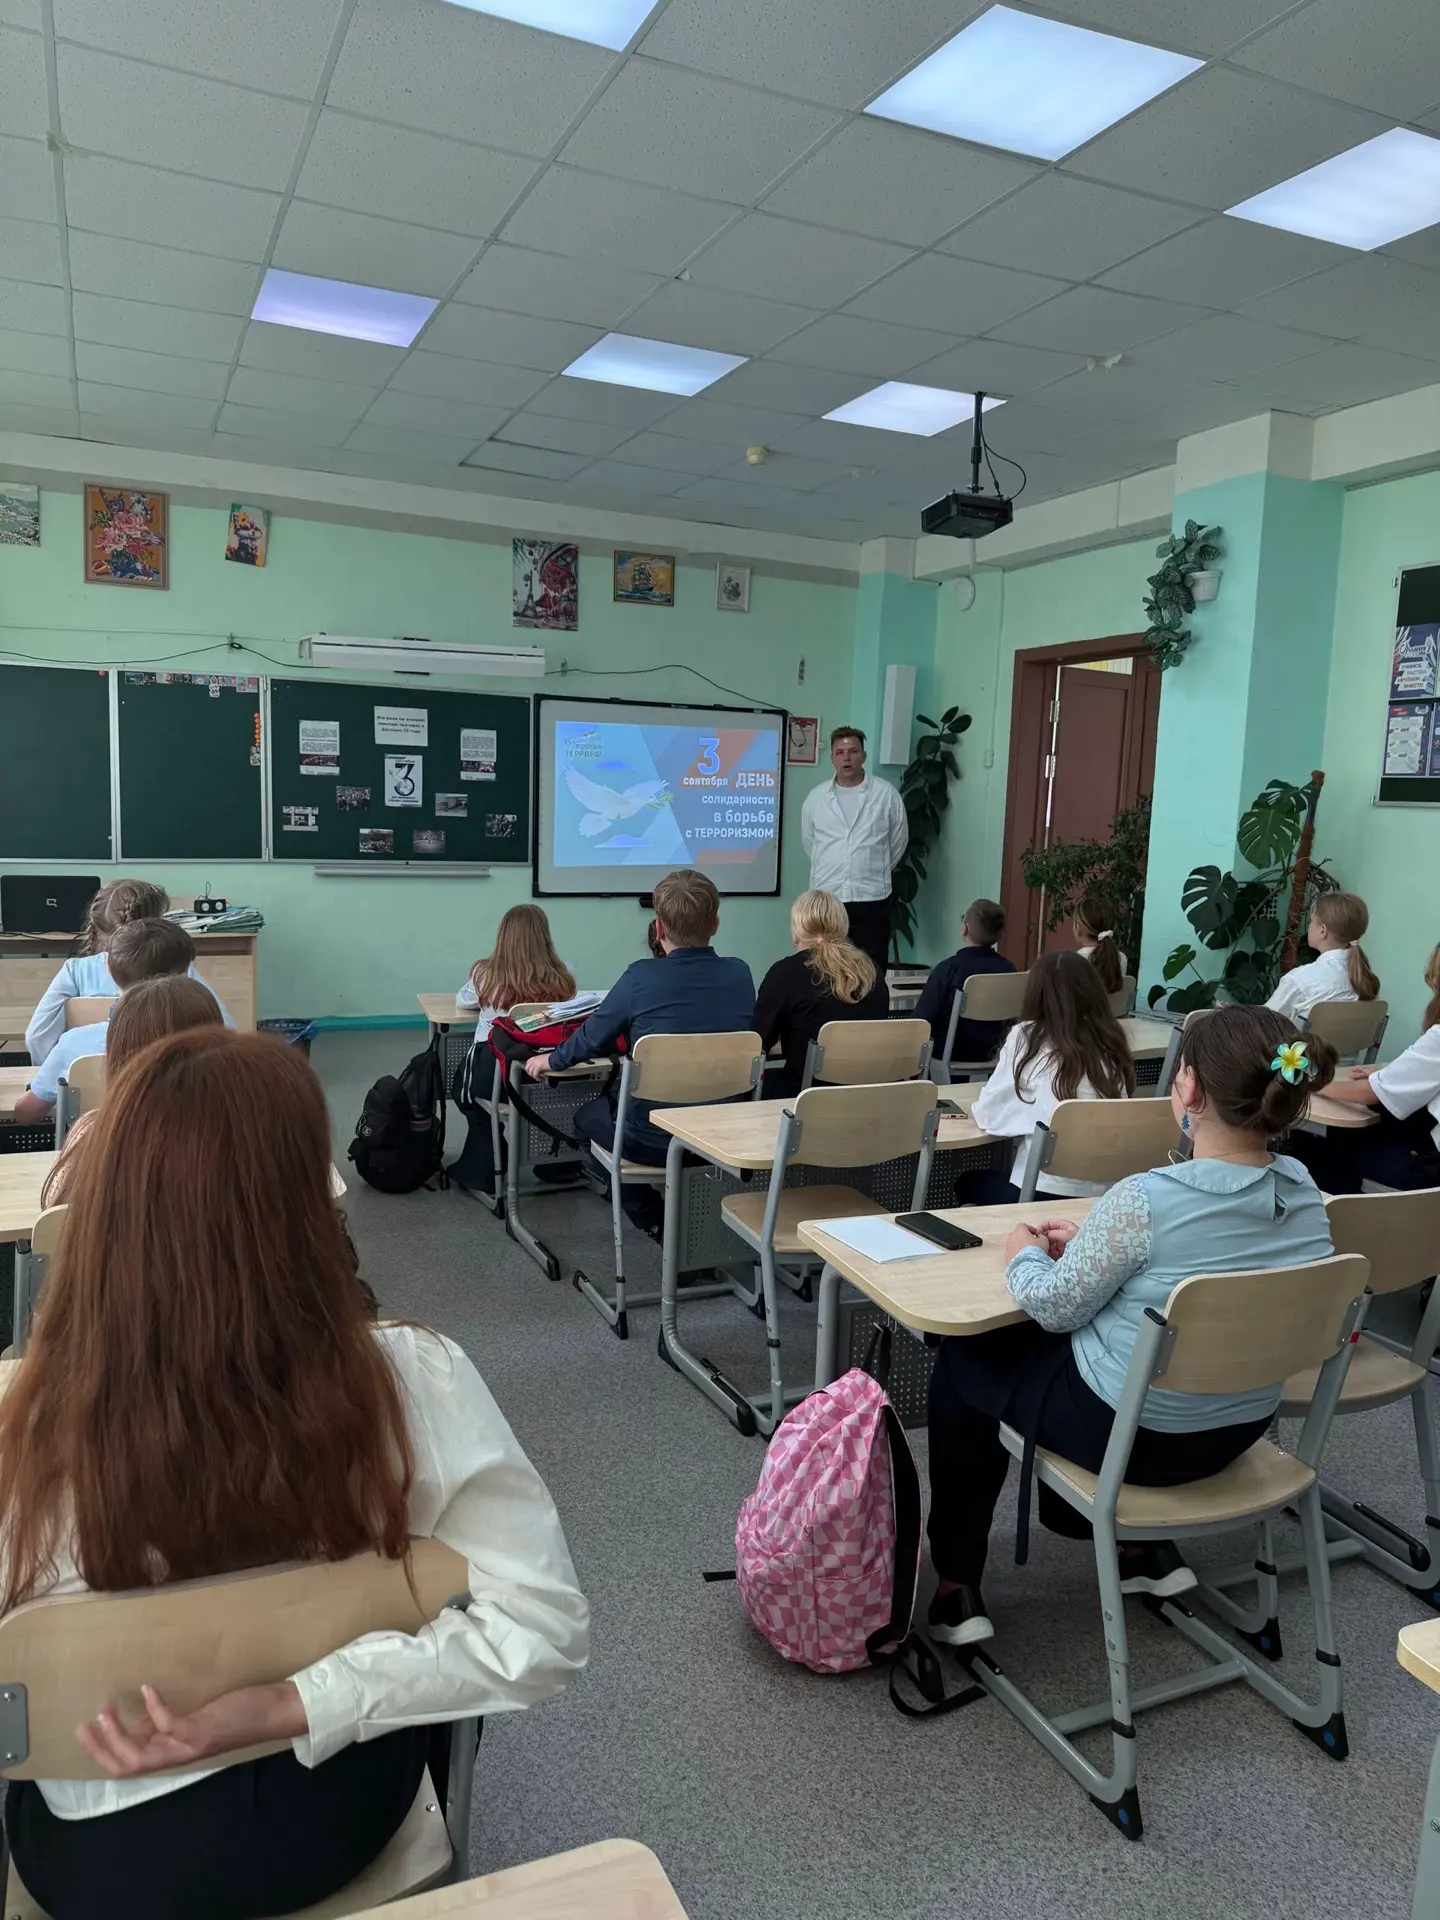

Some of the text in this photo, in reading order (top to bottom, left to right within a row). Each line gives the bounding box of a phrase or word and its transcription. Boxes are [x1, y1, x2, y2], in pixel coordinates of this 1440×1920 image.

[697, 737, 720, 775] 3
[394, 762, 415, 796] 3
[683, 776, 728, 788] сентября
[736, 772, 775, 788] ДЕНЬ
[702, 795, 775, 806] солидарности
[714, 810, 774, 825] в борьбе
[685, 827, 774, 838] с ТЕРРОРИЗМОМ
